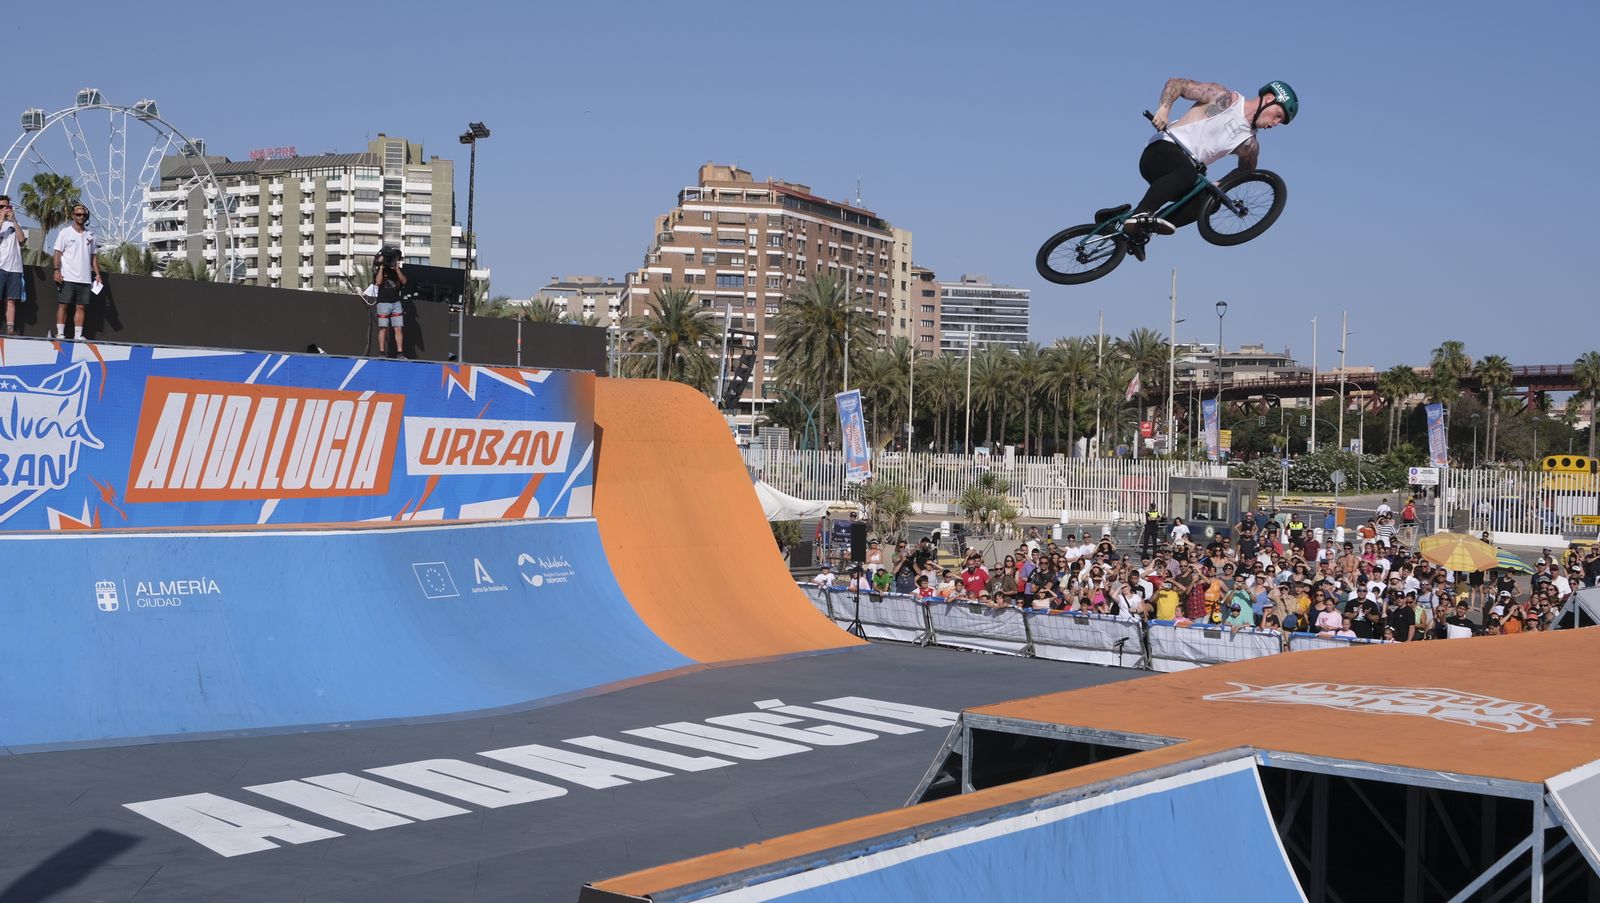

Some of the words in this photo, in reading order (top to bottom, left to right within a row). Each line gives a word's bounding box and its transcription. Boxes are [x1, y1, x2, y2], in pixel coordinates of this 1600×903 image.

[134, 390, 392, 489] ANDALUCÍA
[418, 428, 564, 467] URBAN
[136, 576, 221, 596] ALMERÍA
[137, 598, 182, 608] CIUDAD
[121, 696, 959, 857] ANDALUCÍA
